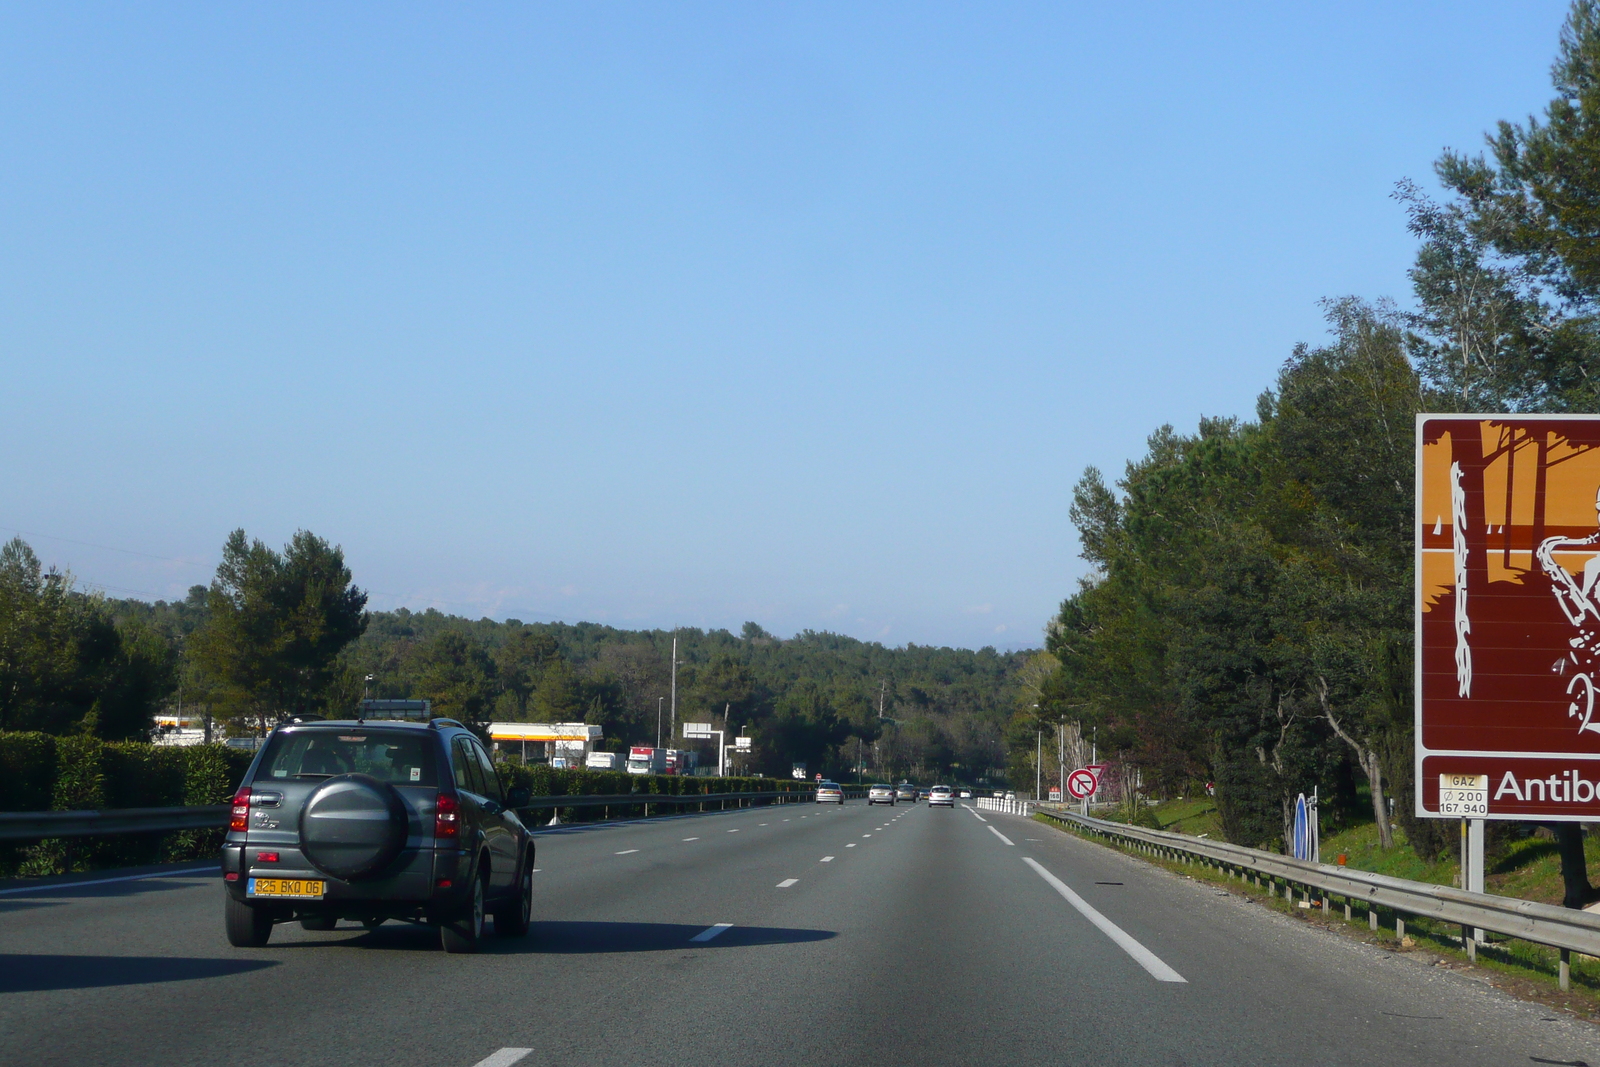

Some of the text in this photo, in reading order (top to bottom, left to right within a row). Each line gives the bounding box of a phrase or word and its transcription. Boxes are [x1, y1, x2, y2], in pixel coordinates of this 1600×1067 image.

[1452, 776, 1475, 787] GAZ
[1458, 791, 1483, 802] 200
[1440, 803, 1486, 814] 167.940
[255, 880, 320, 894] 925 BKQ 06
